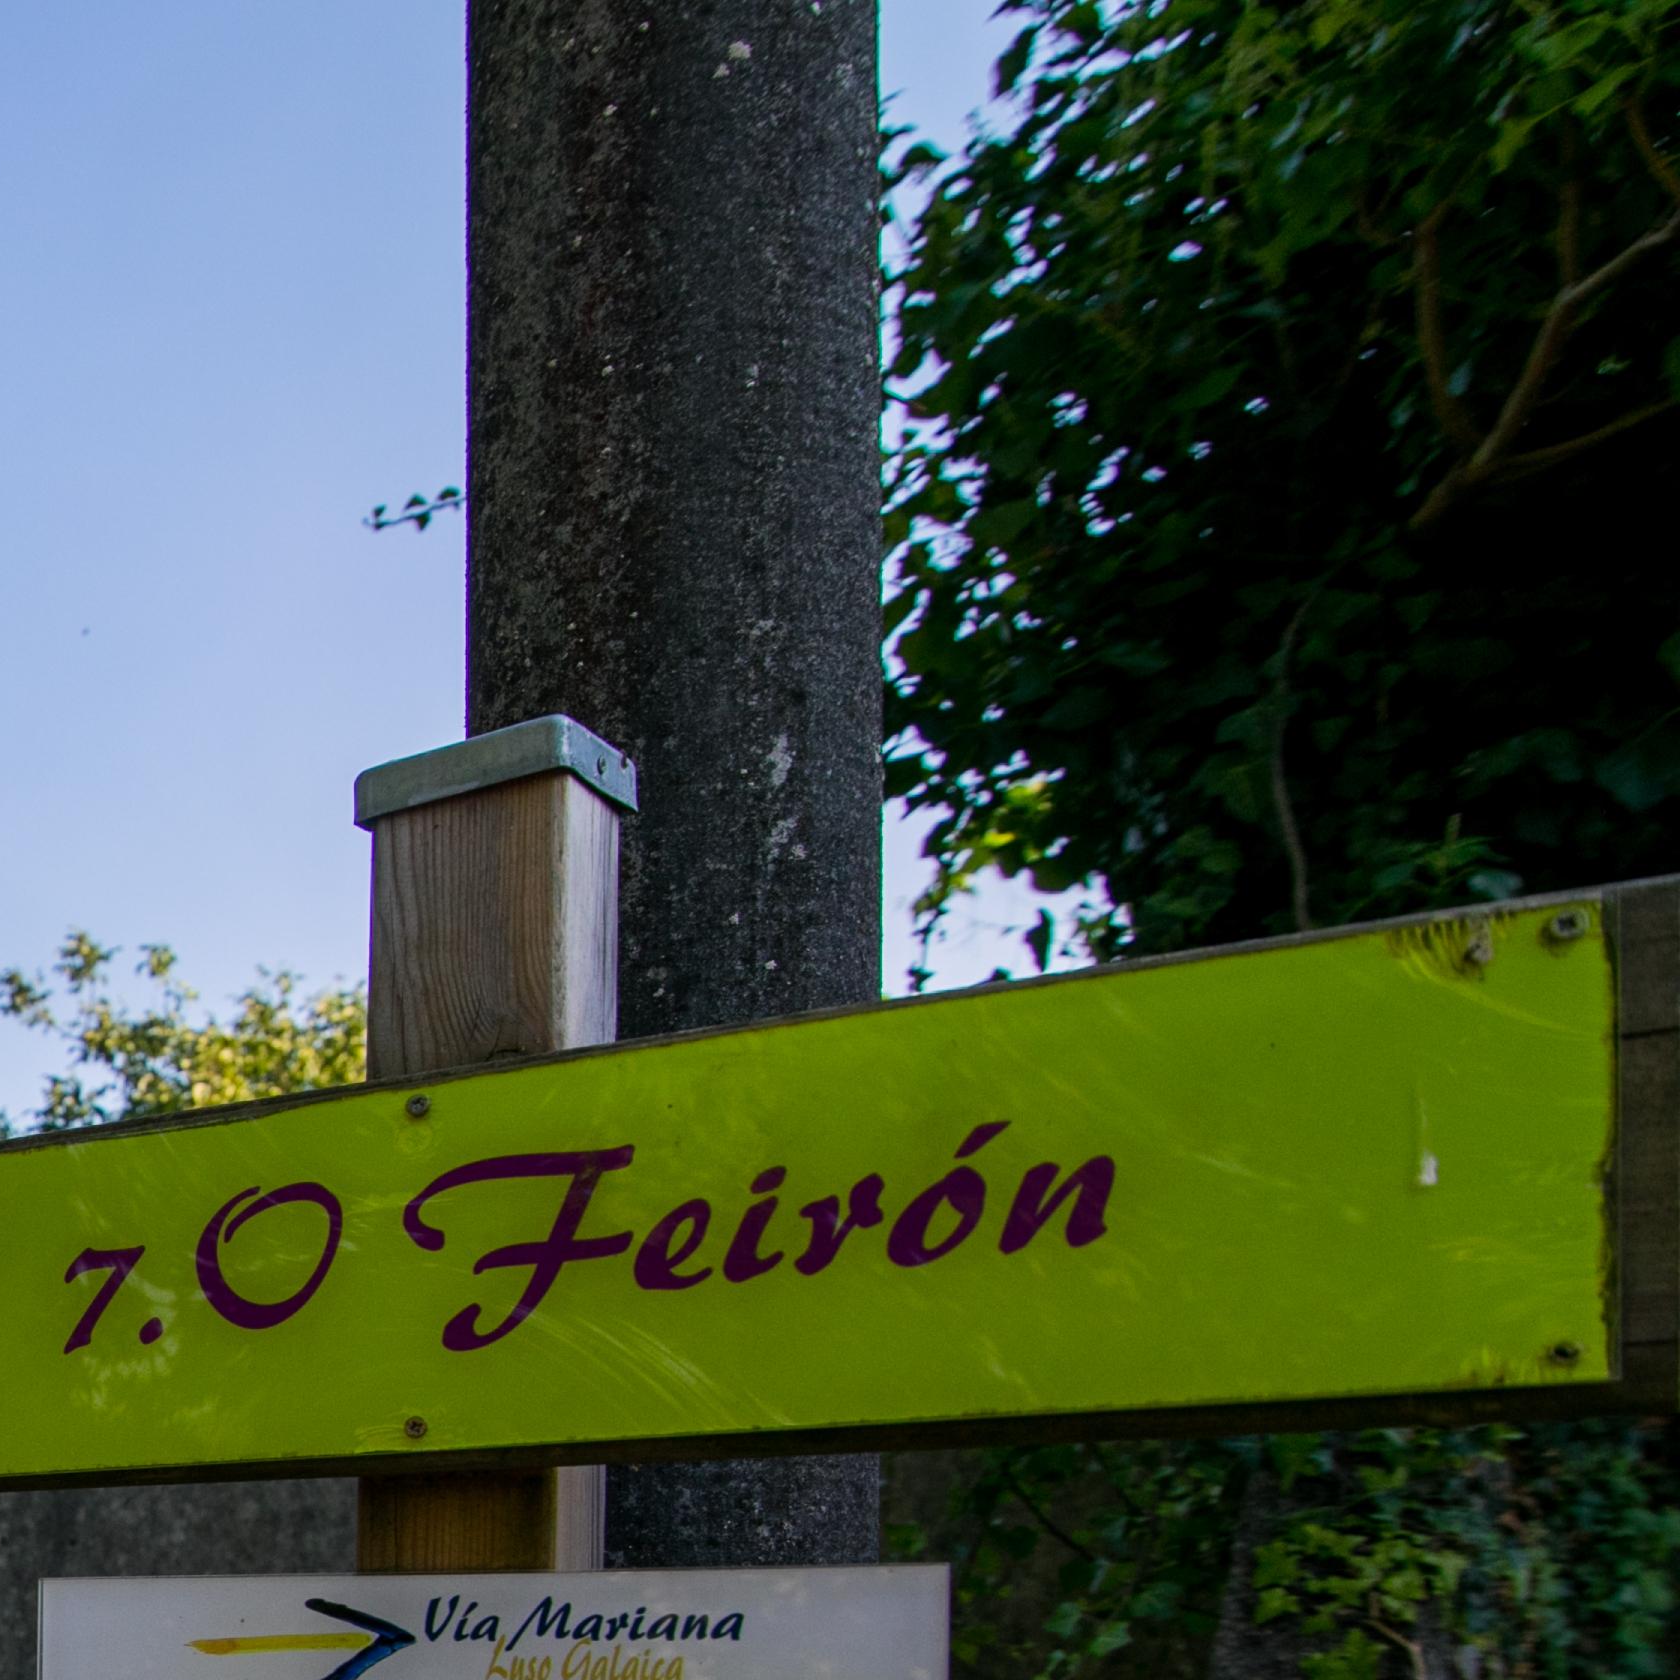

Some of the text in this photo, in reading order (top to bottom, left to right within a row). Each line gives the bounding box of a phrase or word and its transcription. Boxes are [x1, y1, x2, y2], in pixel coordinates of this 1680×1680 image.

[403, 1120, 1115, 1352] Feirón
[424, 1595, 745, 1652] Vía Mariana
